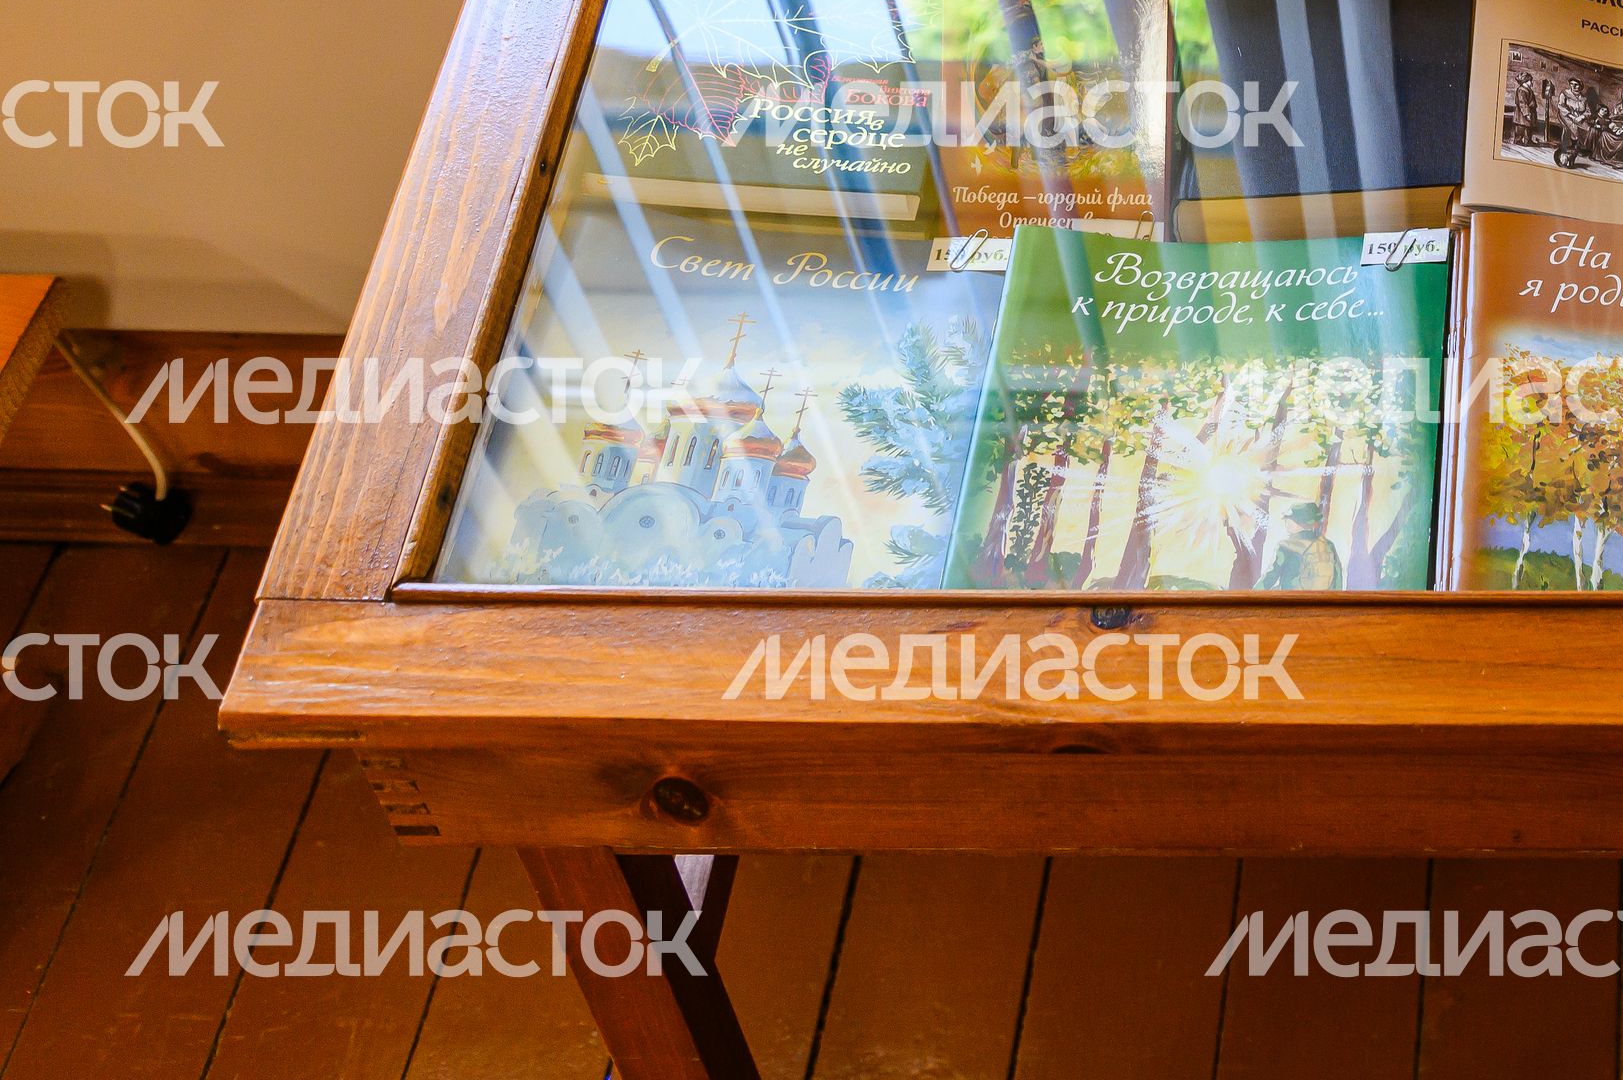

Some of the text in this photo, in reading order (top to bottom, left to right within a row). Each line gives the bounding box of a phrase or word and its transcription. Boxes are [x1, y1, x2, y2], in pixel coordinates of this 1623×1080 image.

[792, 126, 907, 151] сердце
[791, 152, 912, 176] случайно
[952, 184, 1020, 211] Победа
[650, 235, 921, 294] Свет России
[1547, 231, 1612, 270] На
[1094, 251, 1359, 303] Возвращаюсь
[1518, 277, 1541, 299] я
[1071, 288, 1385, 337] к природе, к себе...
